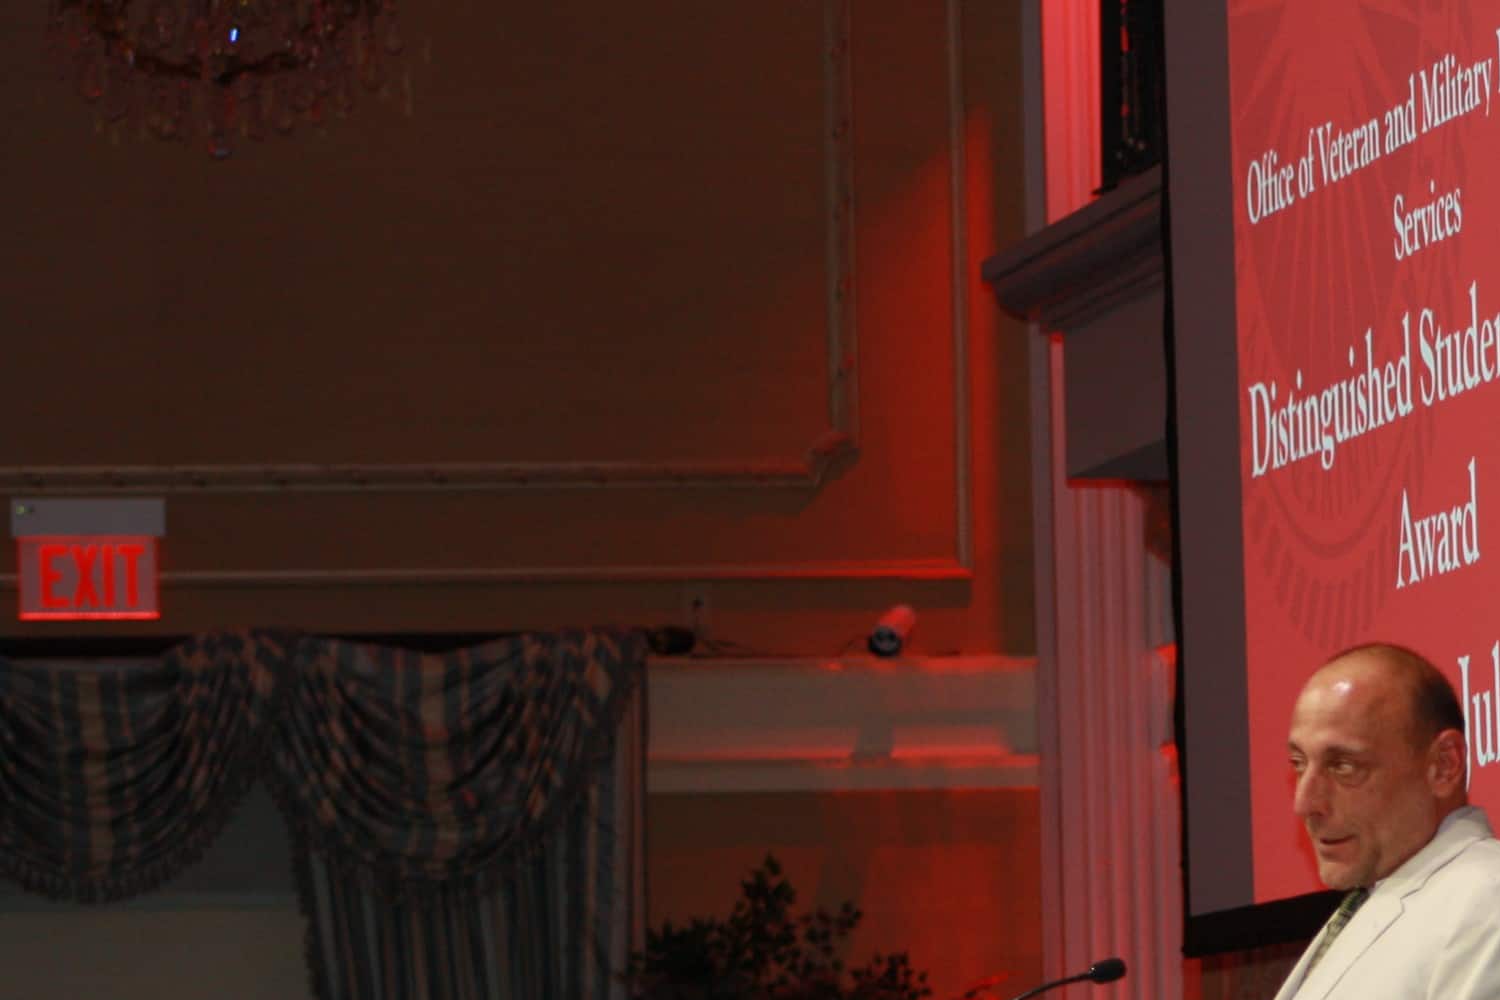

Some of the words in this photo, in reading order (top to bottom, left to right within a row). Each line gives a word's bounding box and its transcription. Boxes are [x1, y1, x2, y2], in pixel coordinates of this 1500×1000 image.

[1247, 147, 1295, 224] Office
[1298, 129, 1316, 199] of
[1316, 119, 1381, 186] Veteran
[1384, 74, 1417, 155] and
[1419, 53, 1493, 134] Military
[1393, 181, 1462, 261] Services
[1248, 311, 1414, 477] Distinguished
[39, 543, 145, 608] EXIT
[1396, 456, 1481, 589] Award
